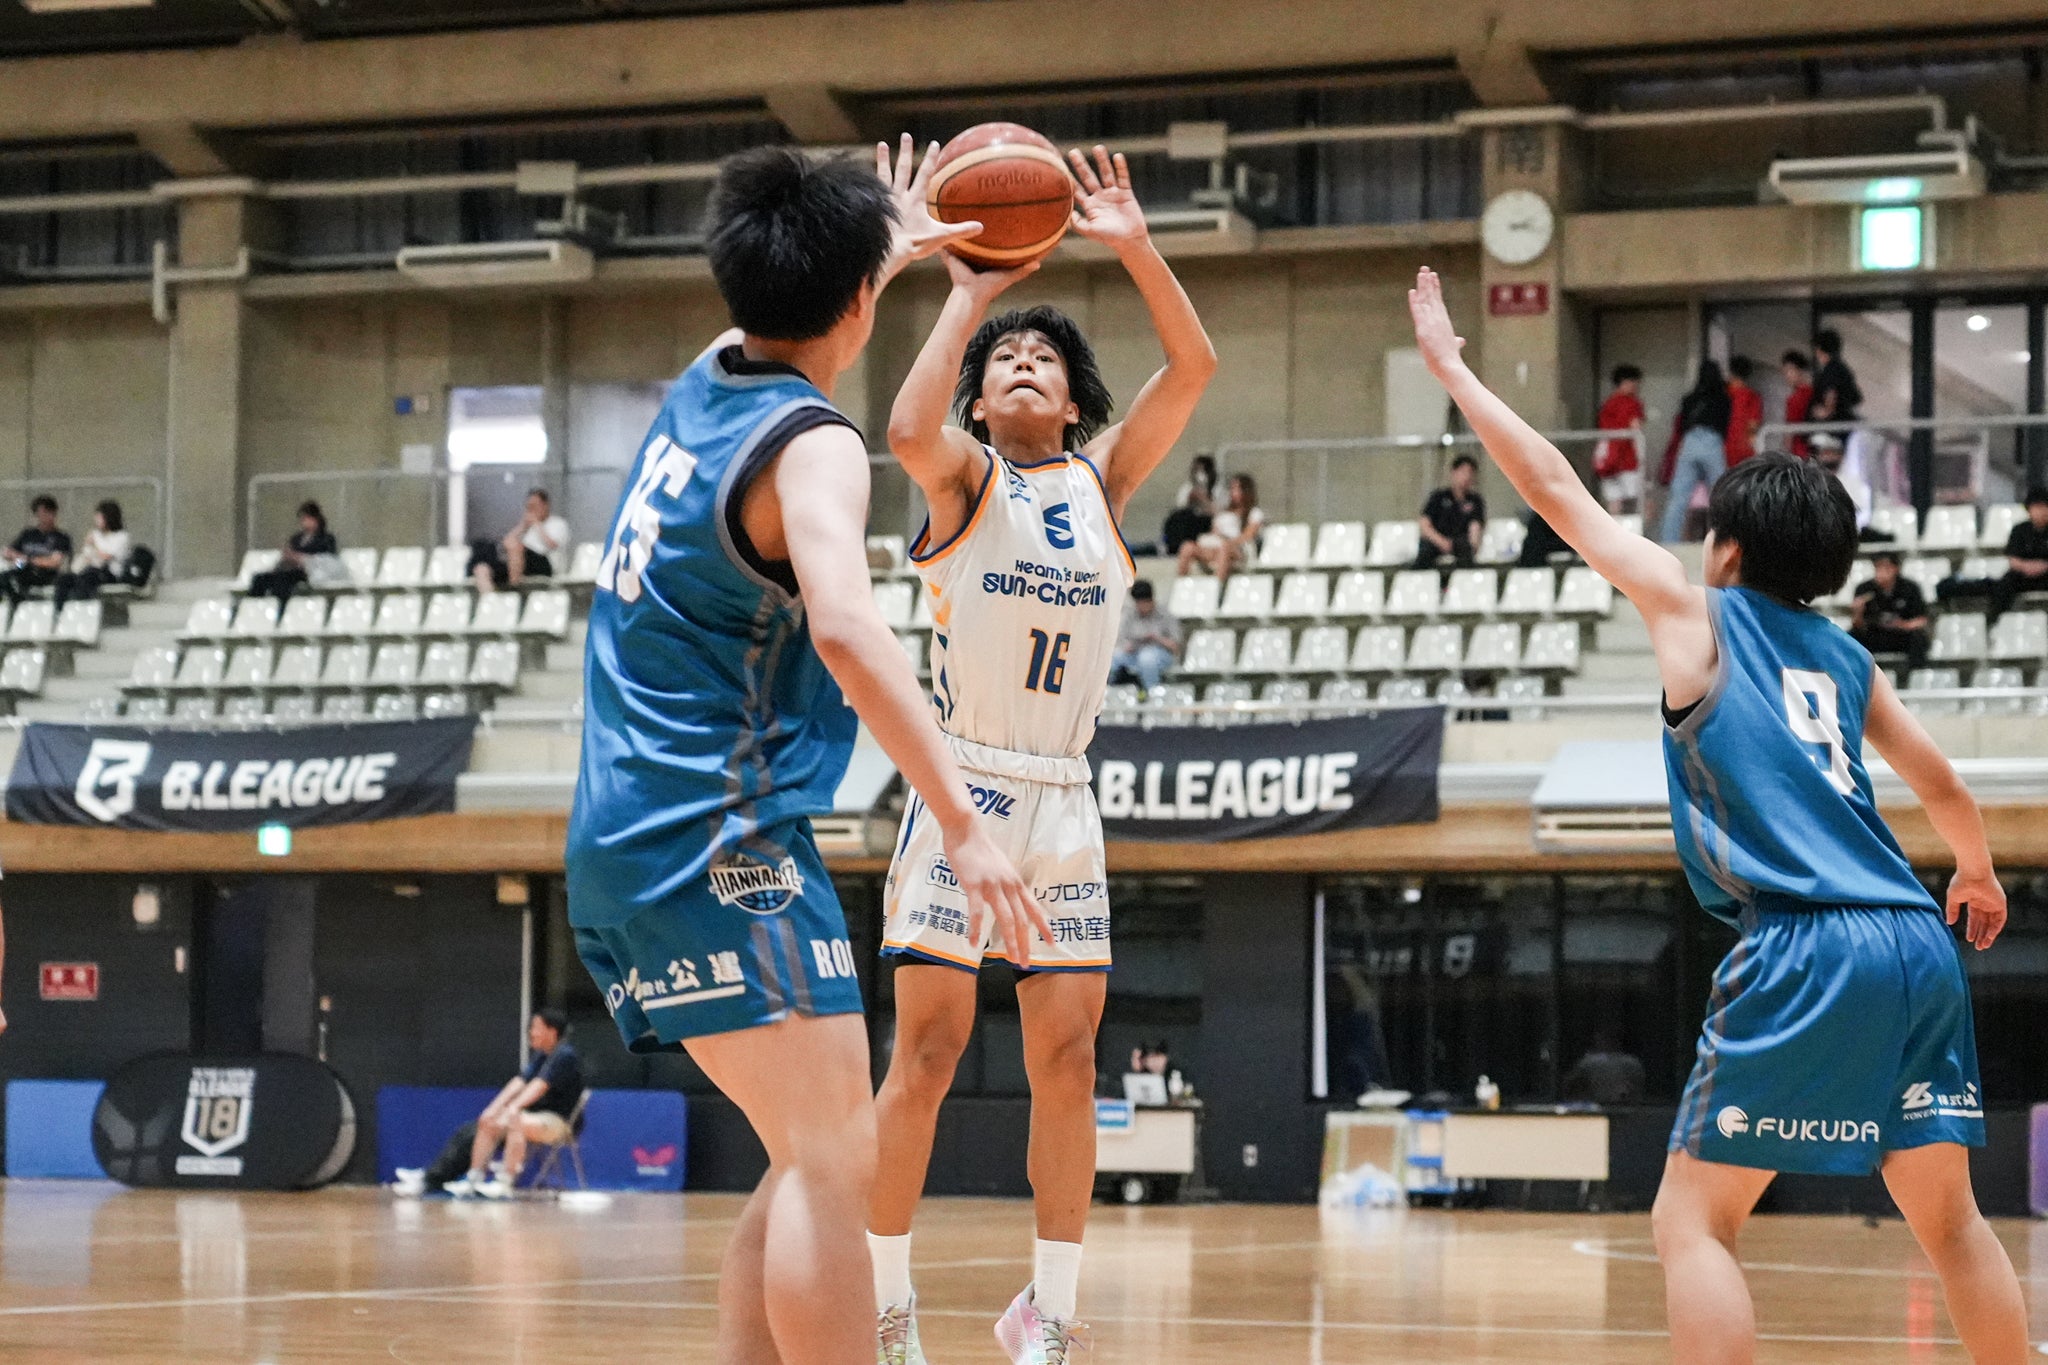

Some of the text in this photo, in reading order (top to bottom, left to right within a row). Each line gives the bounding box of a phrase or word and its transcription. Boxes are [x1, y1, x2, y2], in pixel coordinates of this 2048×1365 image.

[976, 169, 1044, 190] molten
[1024, 627, 1071, 695] 16
[1781, 666, 1857, 797] 9
[160, 751, 397, 811] B.LEAGUE
[1099, 751, 1358, 820] B.LEAGUE
[1755, 1117, 1880, 1143] FUKUDA
